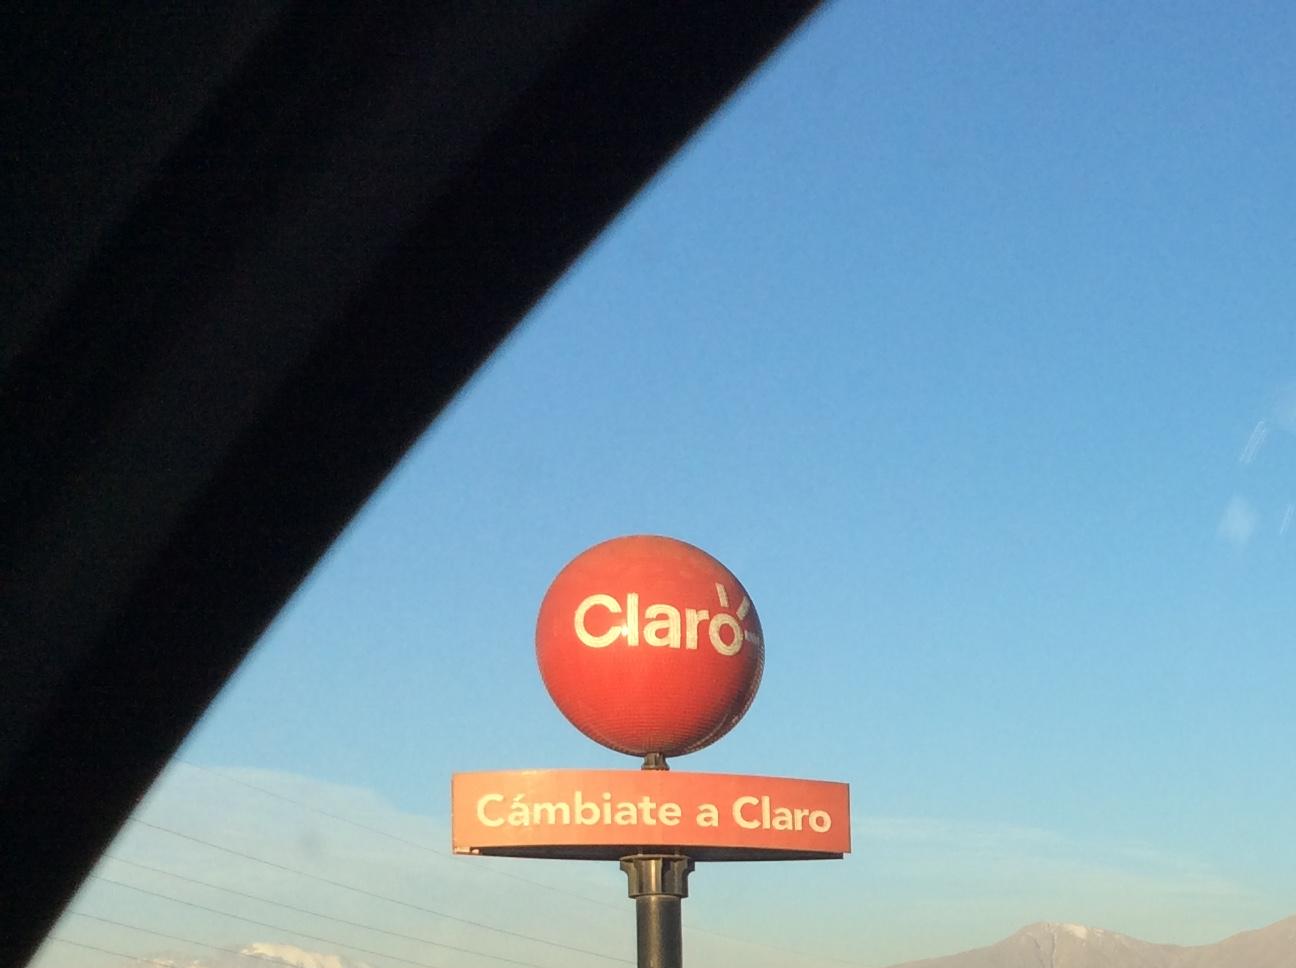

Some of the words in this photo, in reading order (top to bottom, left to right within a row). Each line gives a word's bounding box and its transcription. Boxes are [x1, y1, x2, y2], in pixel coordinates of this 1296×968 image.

[573, 592, 744, 656] Claro
[475, 791, 682, 828] Cámbiate
[696, 803, 719, 827] a
[732, 795, 833, 833] Claro
